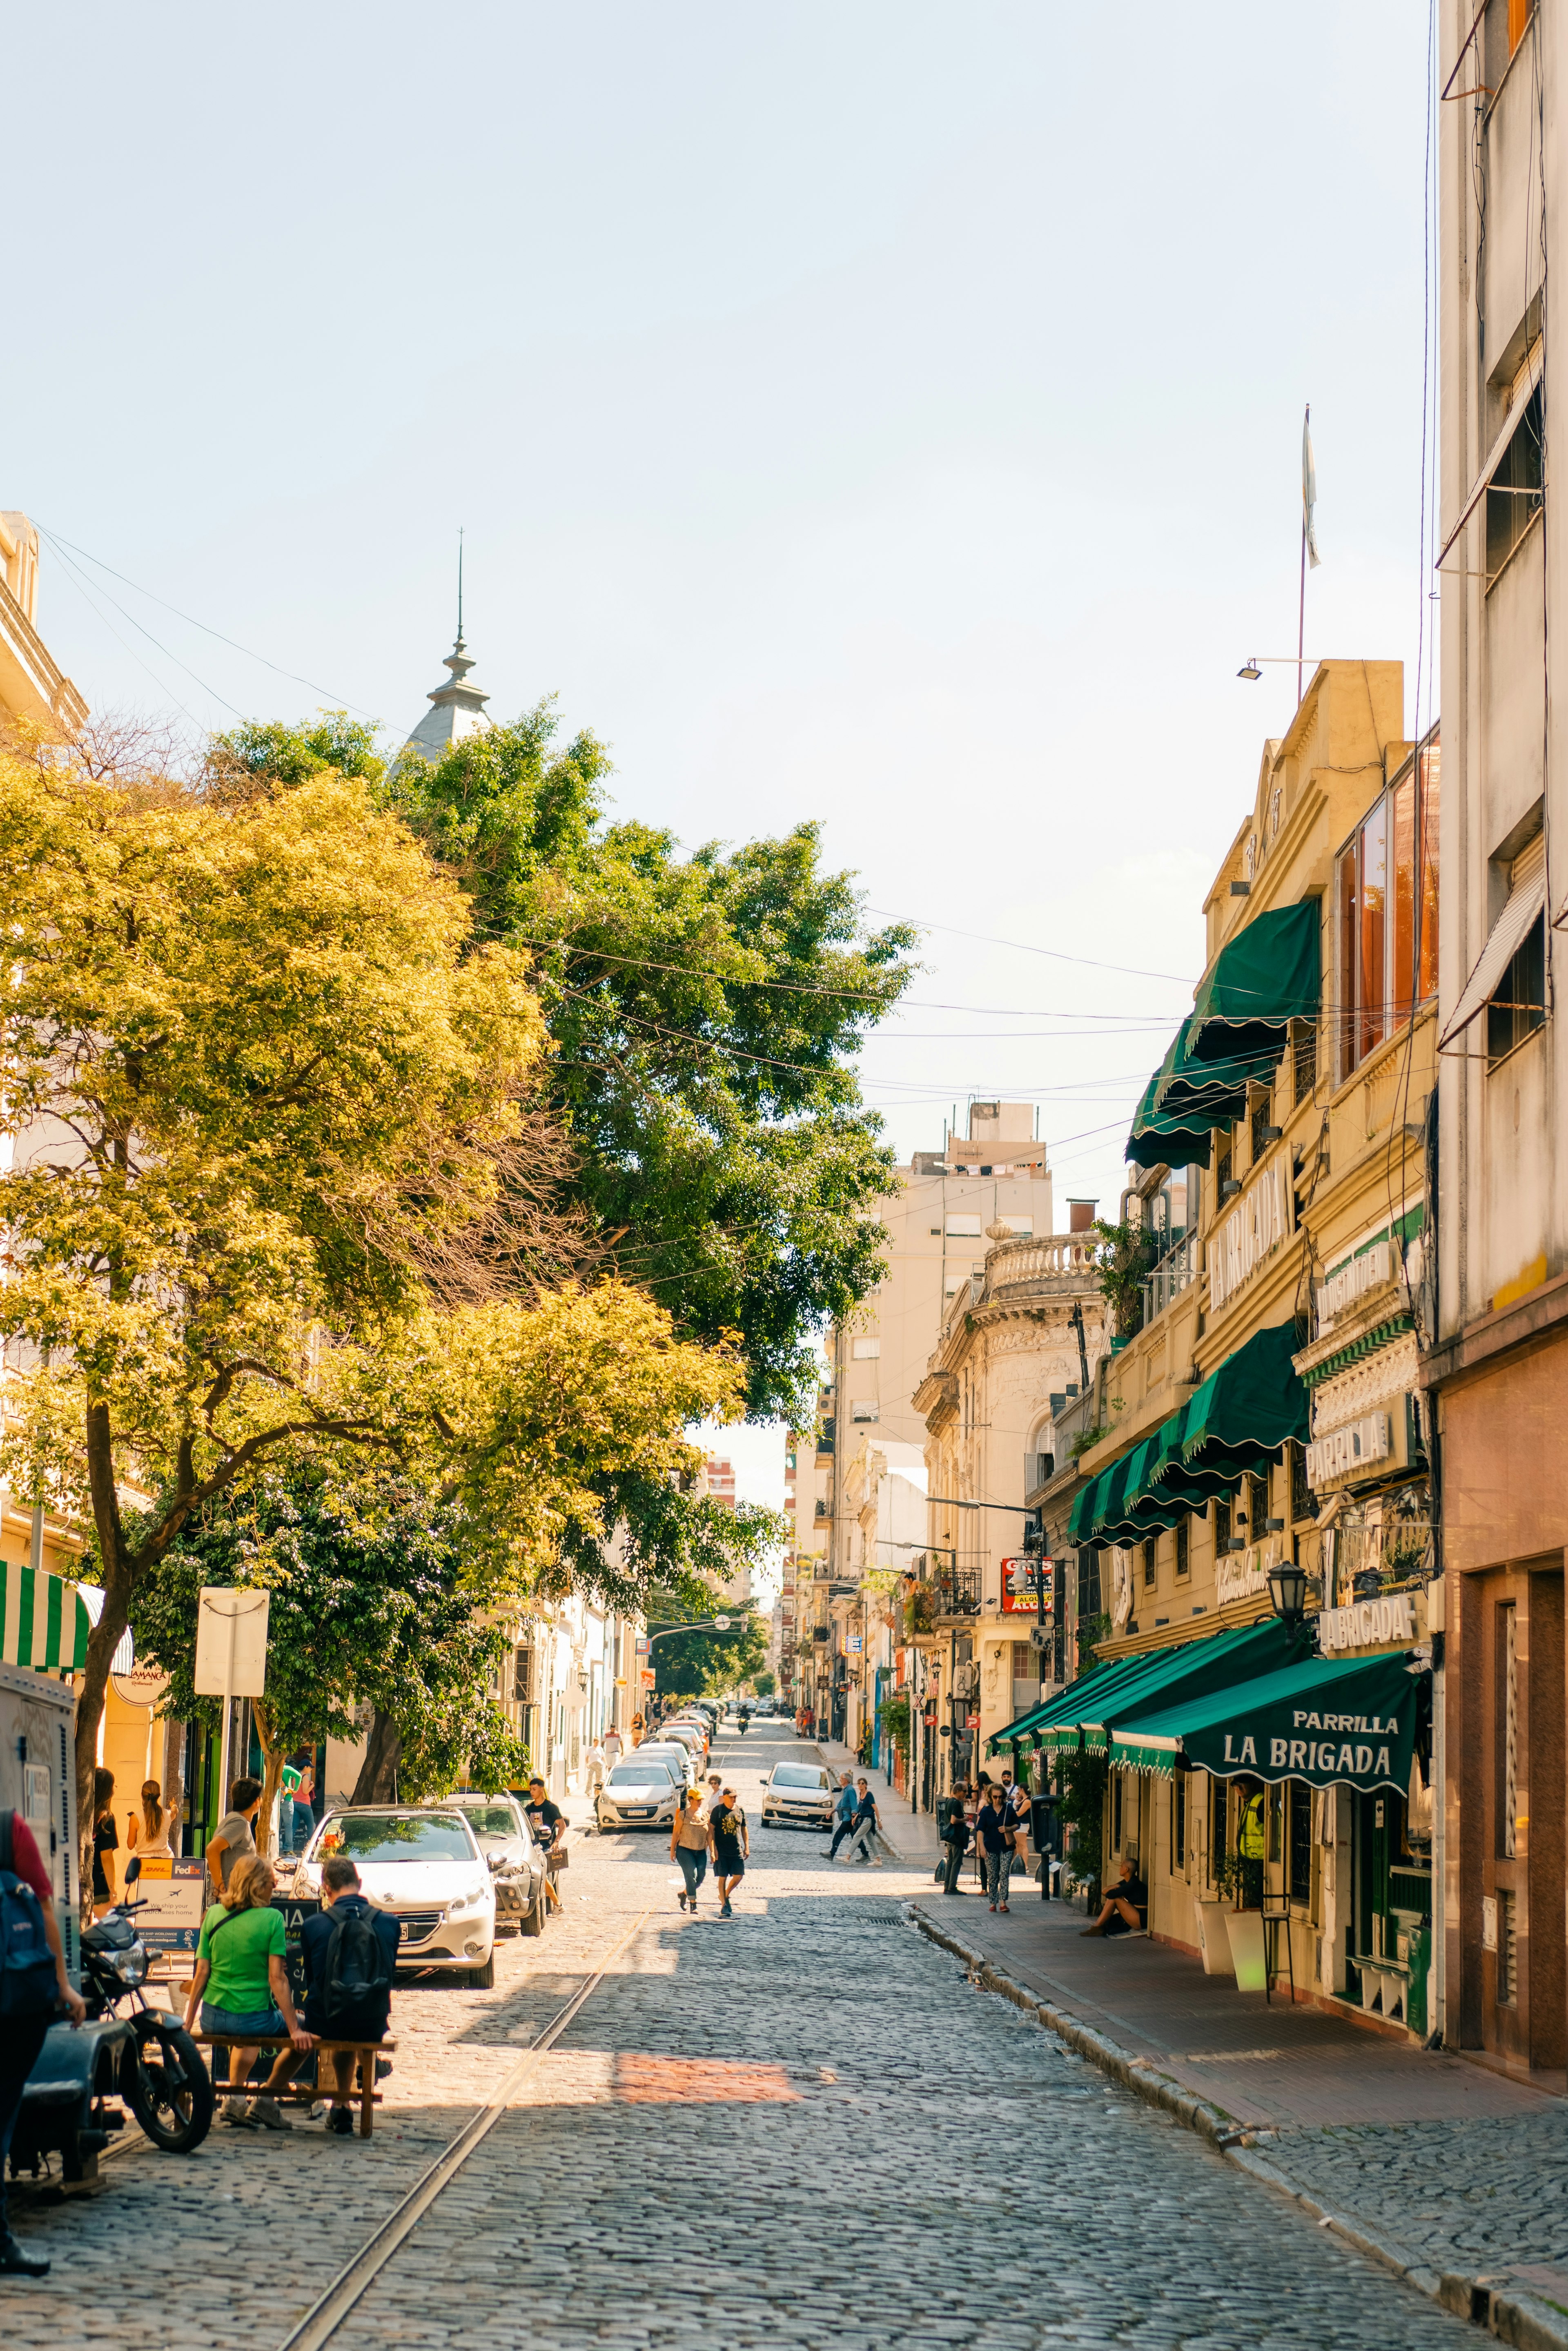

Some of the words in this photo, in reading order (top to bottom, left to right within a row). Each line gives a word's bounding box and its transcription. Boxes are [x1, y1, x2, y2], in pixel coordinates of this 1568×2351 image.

[1209, 1229, 1225, 1314] LA
[1226, 1157, 1284, 1297] BRIGADA
[1306, 1411, 1385, 1489] PARRILLA
[1020, 1594, 1052, 1602] ALQULÓ
[1320, 1609, 1335, 1651] LA
[1338, 1595, 1408, 1649] BRIGADA
[847, 1637, 860, 1652] E
[117, 1670, 167, 1680] LAMANCA
[913, 1696, 923, 1707] X
[1293, 1711, 1399, 1734] PARRILLA
[1224, 1735, 1257, 1764] LA
[1270, 1738, 1391, 1775] BRIGADA
[175, 1865, 200, 1874] FedEx
